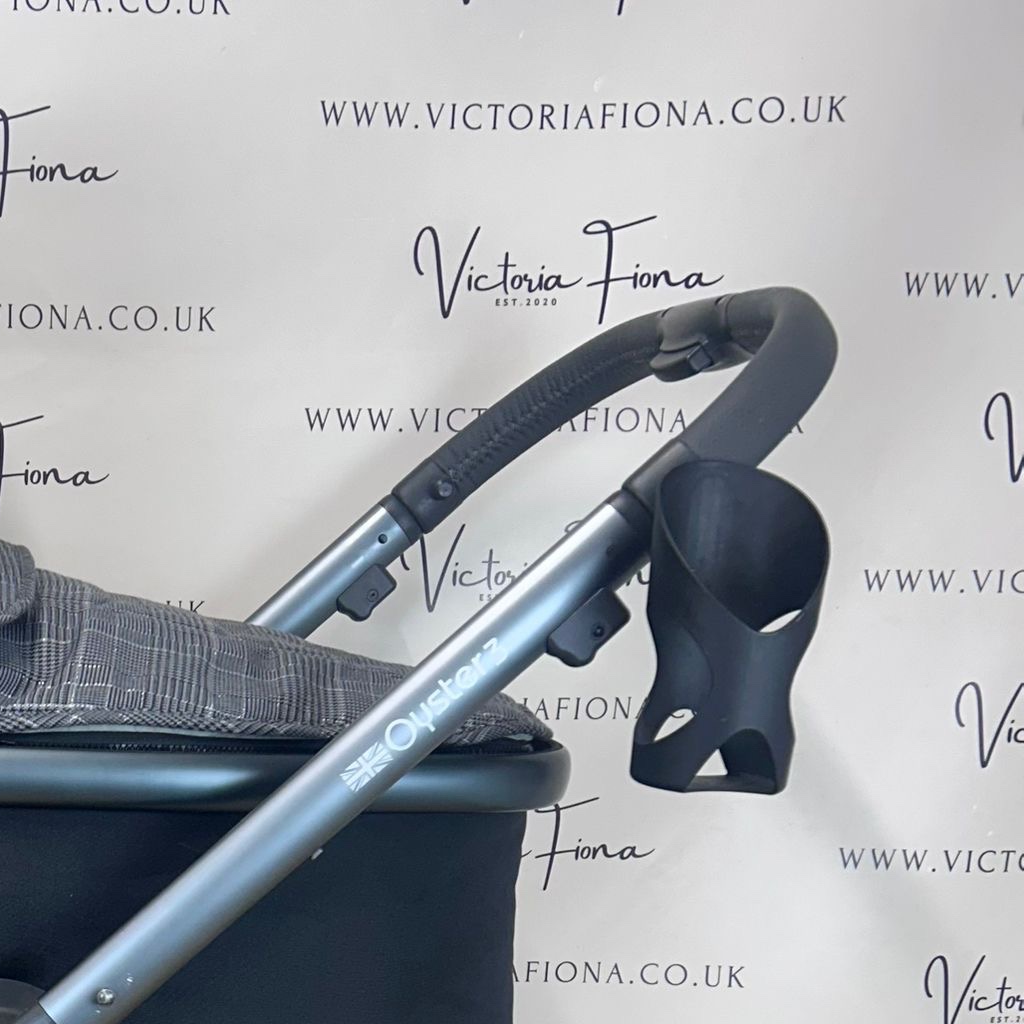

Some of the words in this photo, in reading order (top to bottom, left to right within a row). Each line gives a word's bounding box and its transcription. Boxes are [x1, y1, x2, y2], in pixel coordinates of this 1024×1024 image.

[320, 96, 847, 130] WWW.VICTORIAFIONA.CO.UK
[413, 226, 582, 320] Victoria
[582, 215, 725, 325] Fiona
[494, 298, 559, 307] EST.2020
